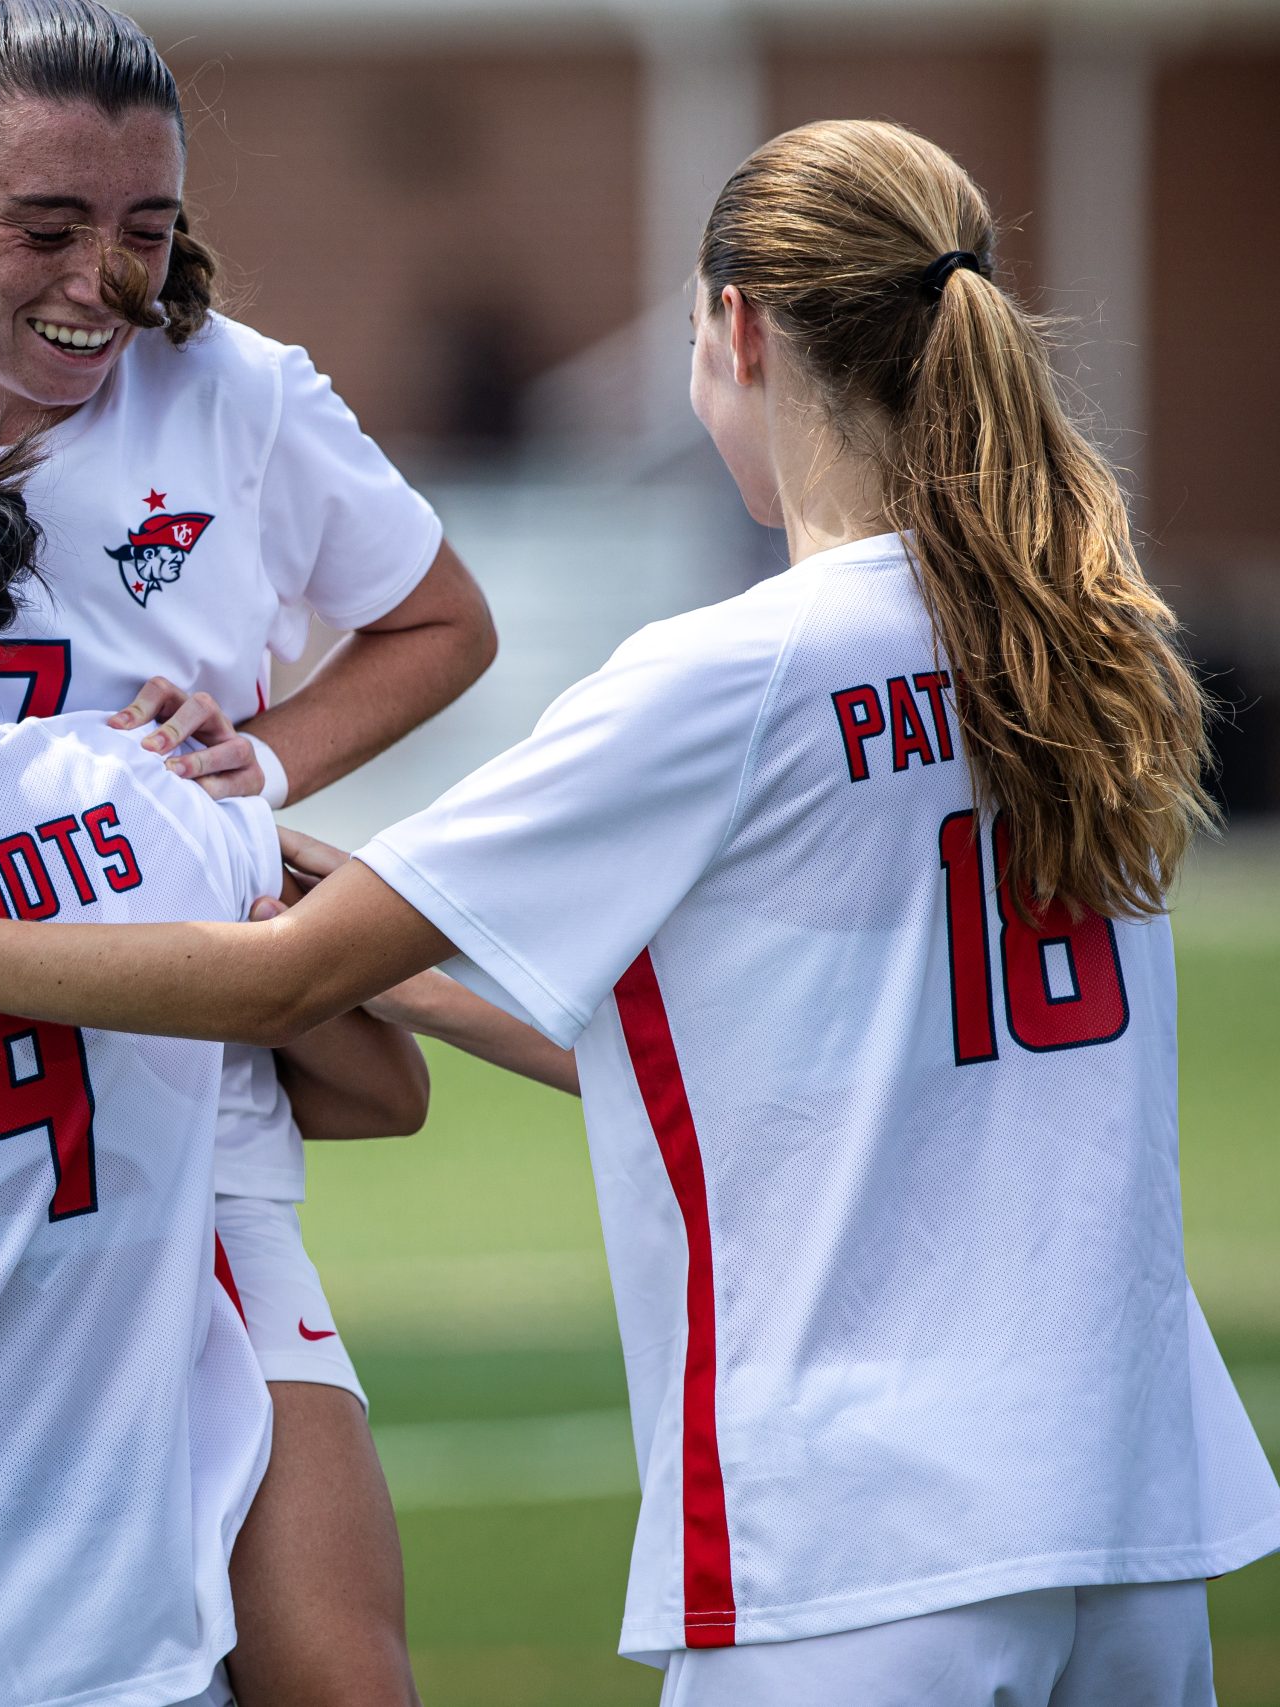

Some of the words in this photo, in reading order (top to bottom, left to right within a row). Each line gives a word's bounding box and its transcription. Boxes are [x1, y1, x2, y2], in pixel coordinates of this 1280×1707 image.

[172, 524, 193, 546] UC
[831, 669, 970, 783] PAT
[939, 808, 1130, 1066] 18
